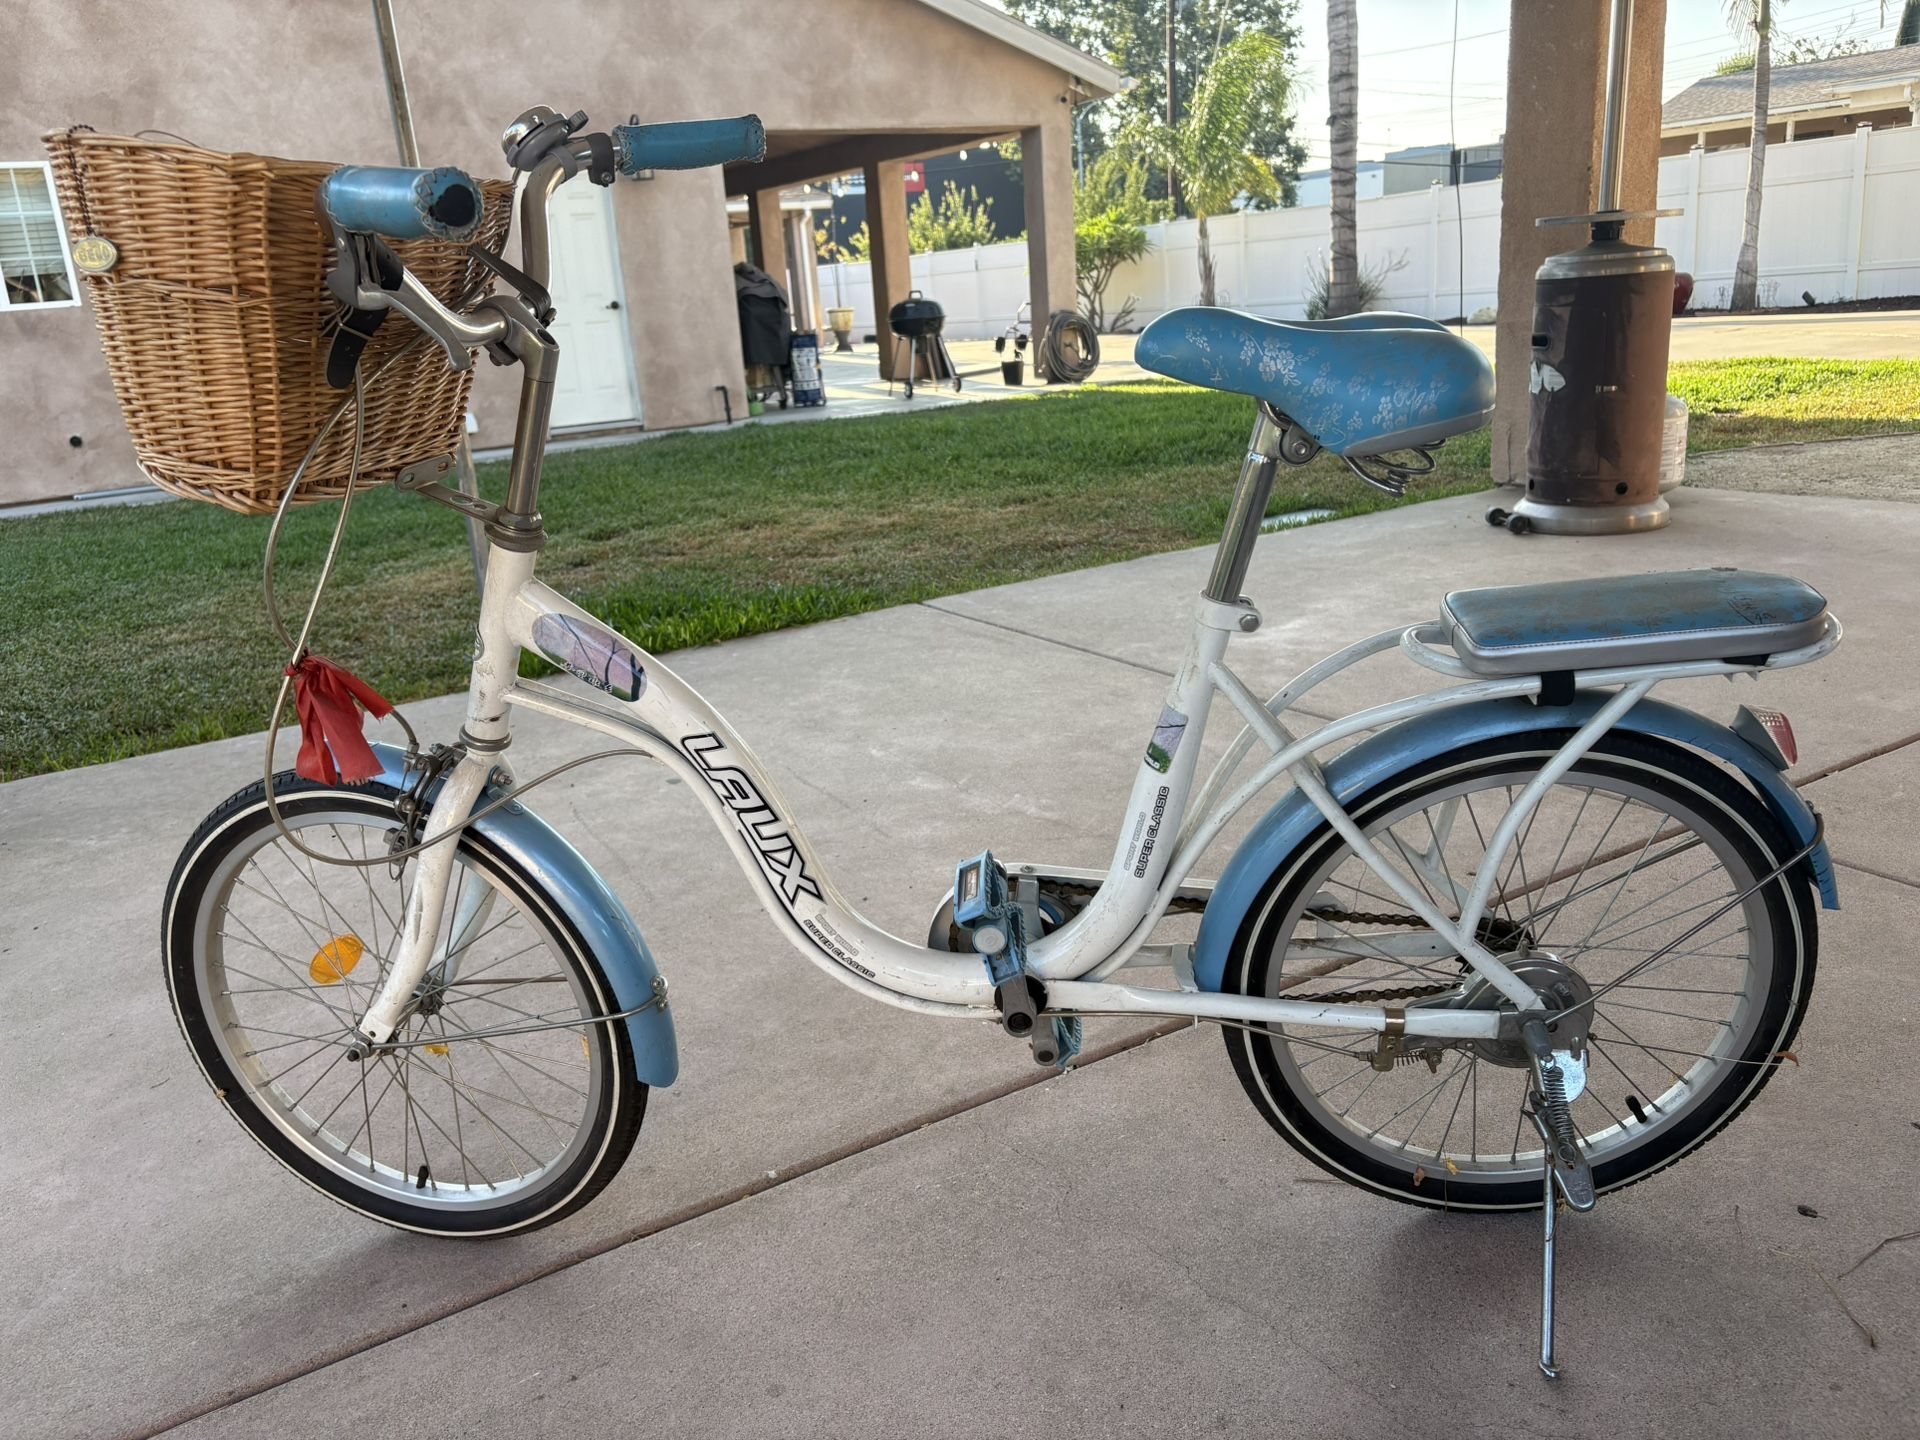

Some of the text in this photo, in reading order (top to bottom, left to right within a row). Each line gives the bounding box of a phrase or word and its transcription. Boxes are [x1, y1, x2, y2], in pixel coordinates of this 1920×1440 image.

[680, 731, 826, 906] LAUX
[1134, 838, 1155, 878] SUPER
[1147, 786, 1170, 838] CLASSIC
[803, 919, 876, 979] SUPER CLASSIC
